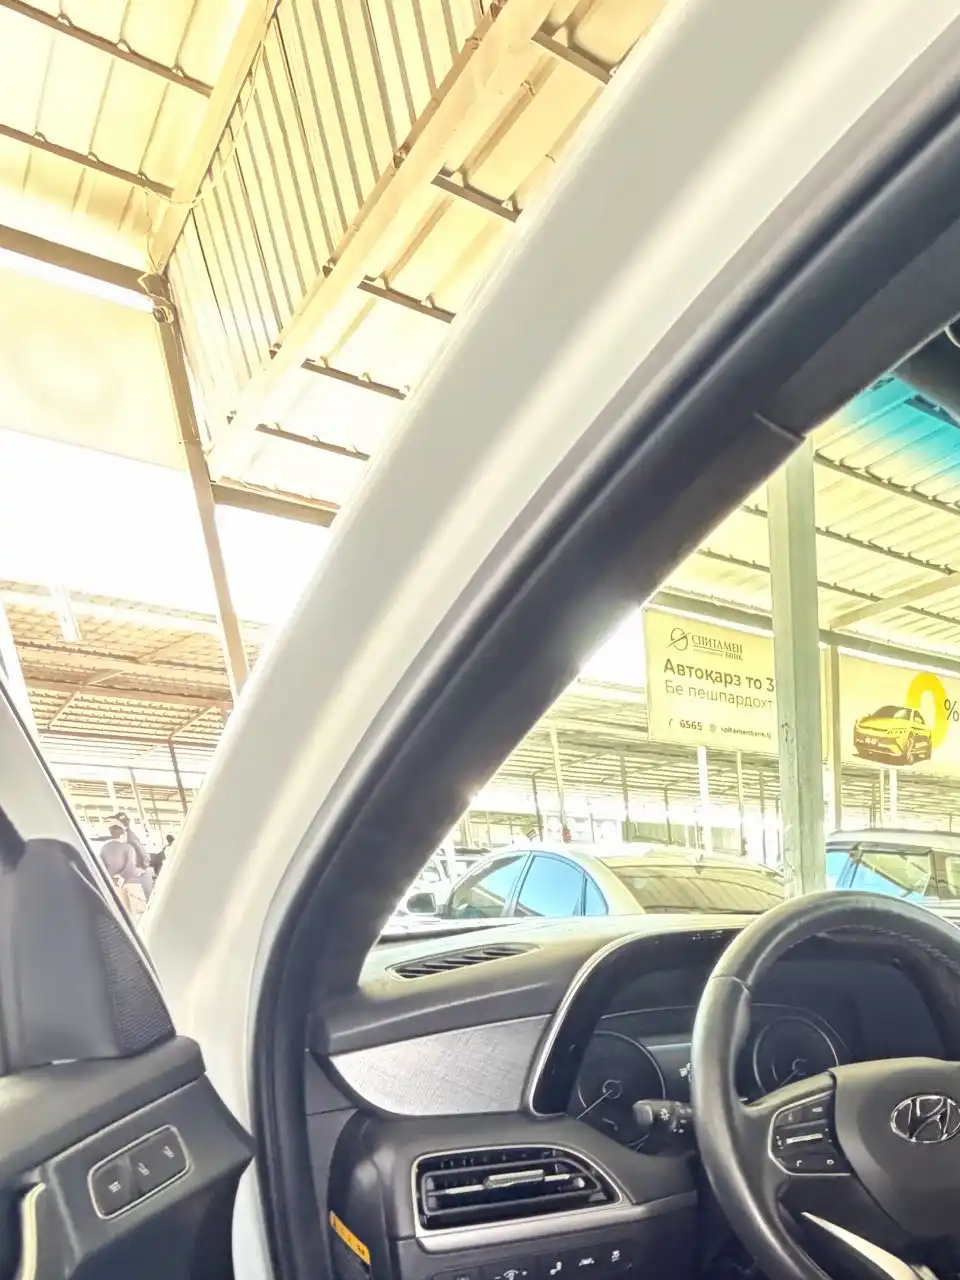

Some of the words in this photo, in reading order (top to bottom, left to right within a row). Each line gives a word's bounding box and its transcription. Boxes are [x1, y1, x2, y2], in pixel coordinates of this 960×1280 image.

[691, 634, 743, 655] СПИТАМЕН
[663, 658, 742, 688] Автоқарз
[745, 676, 762, 690] то
[665, 679, 684, 695] Бе
